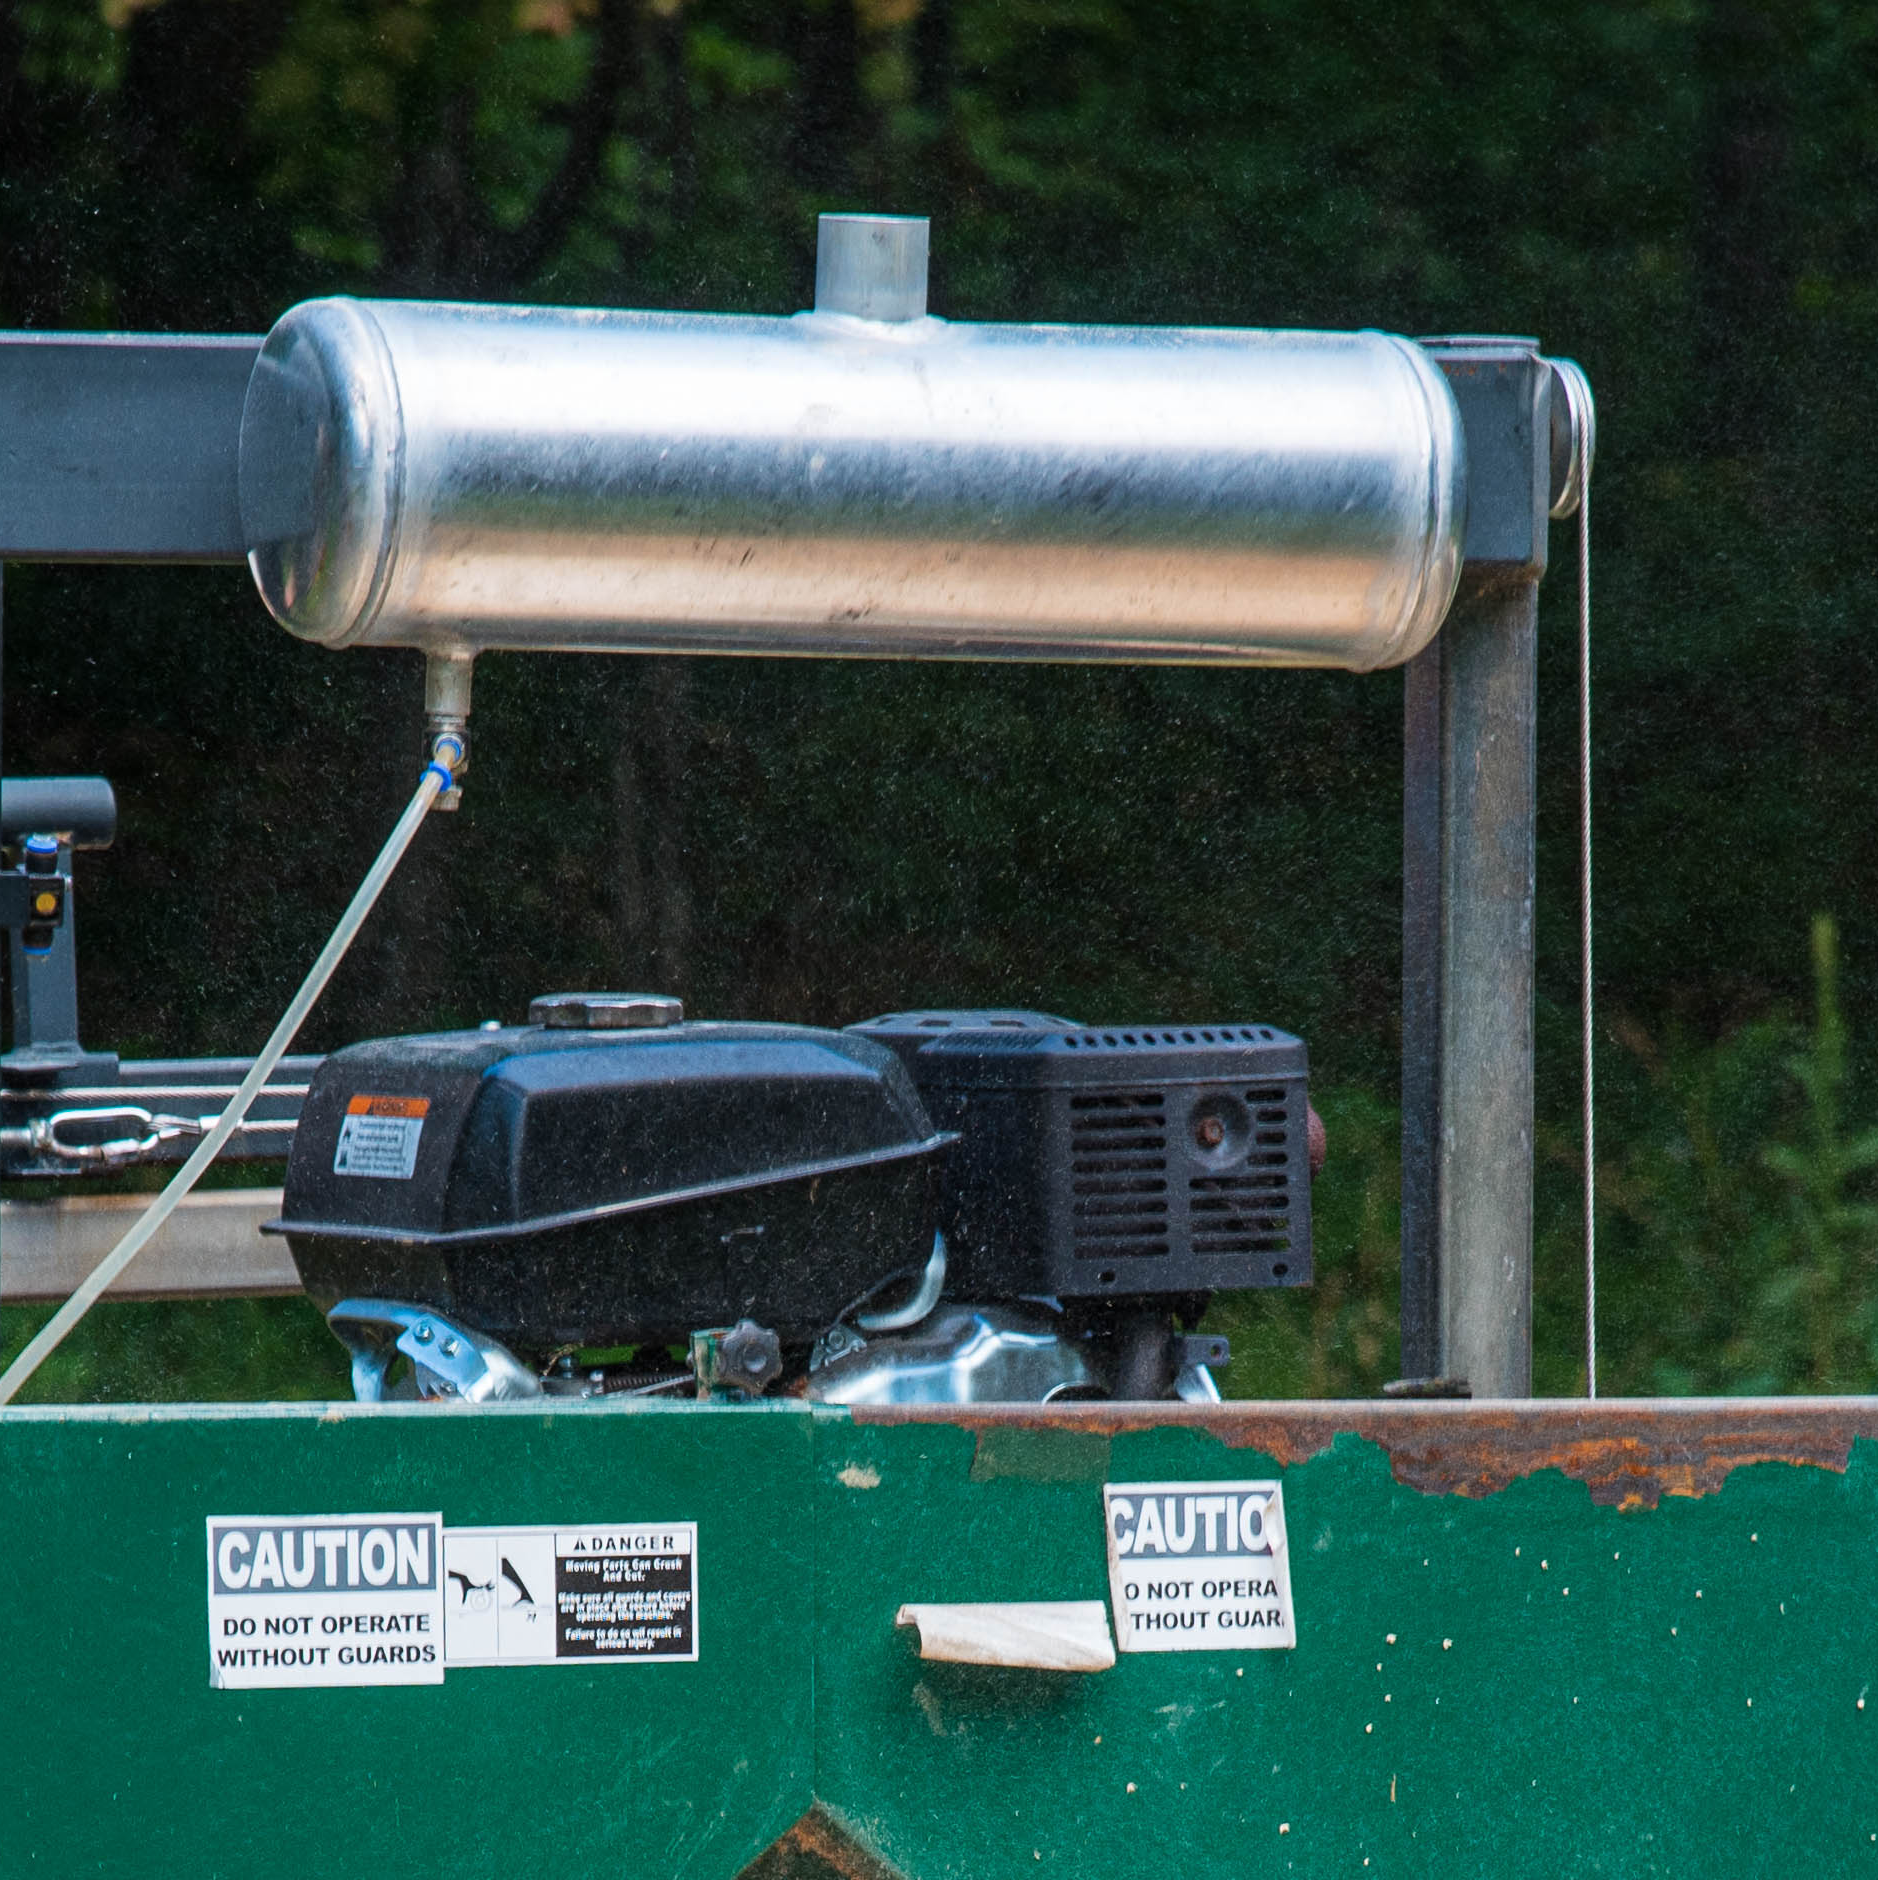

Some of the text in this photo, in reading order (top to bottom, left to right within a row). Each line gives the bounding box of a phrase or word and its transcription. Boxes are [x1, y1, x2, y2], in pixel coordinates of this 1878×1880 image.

[1109, 1494, 1270, 1556] CAUTIO
[592, 1535, 674, 1551] DANGER
[218, 1528, 429, 1589] CAUTION
[565, 1557, 683, 1574] Moving Parts Can Crush
[603, 1570, 622, 1582] And
[1125, 1579, 1278, 1600] O NOT OPERA
[223, 1614, 430, 1636] DO NOT OPERATE
[1130, 1610, 1284, 1630] THOUT GUAR
[218, 1645, 436, 1667] WITHOUT GUARDS
